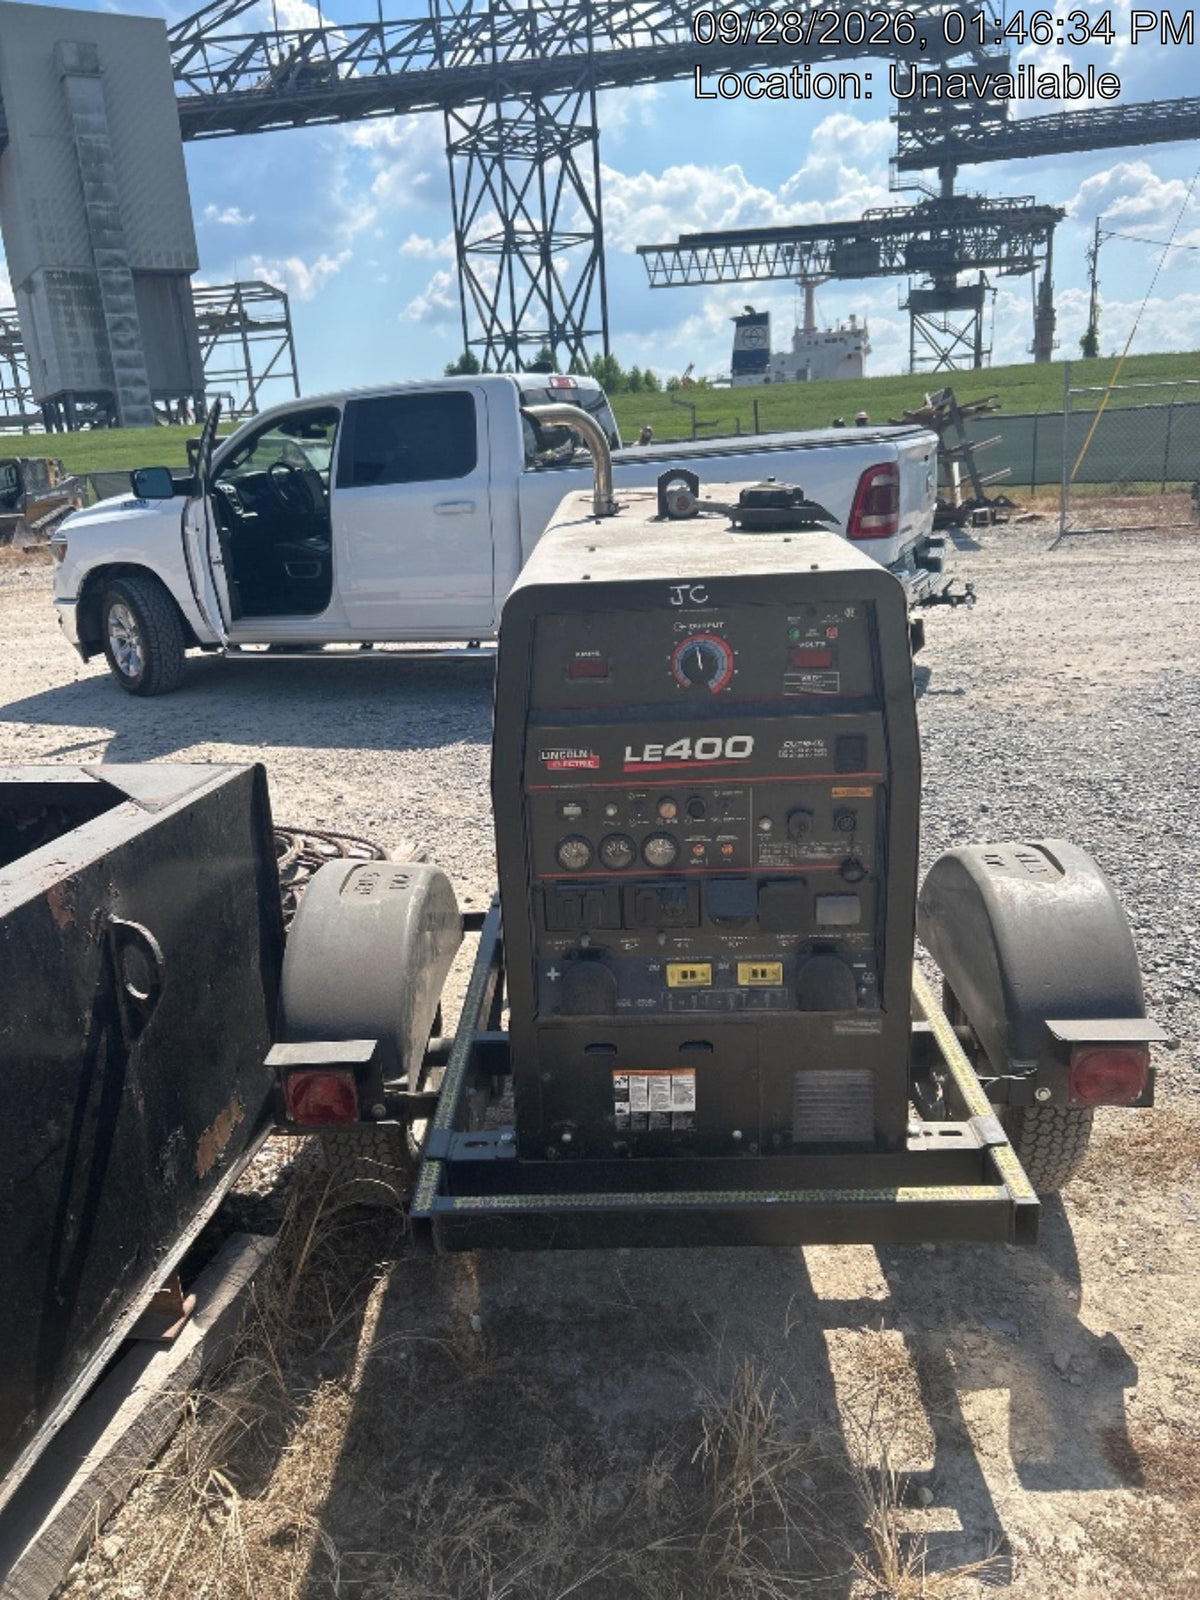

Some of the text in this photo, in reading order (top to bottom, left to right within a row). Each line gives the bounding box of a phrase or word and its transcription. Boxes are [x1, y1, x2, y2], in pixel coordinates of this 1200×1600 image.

[669, 584, 709, 606] JC
[540, 749, 589, 760] LINCOLN
[623, 735, 755, 763] LE400
